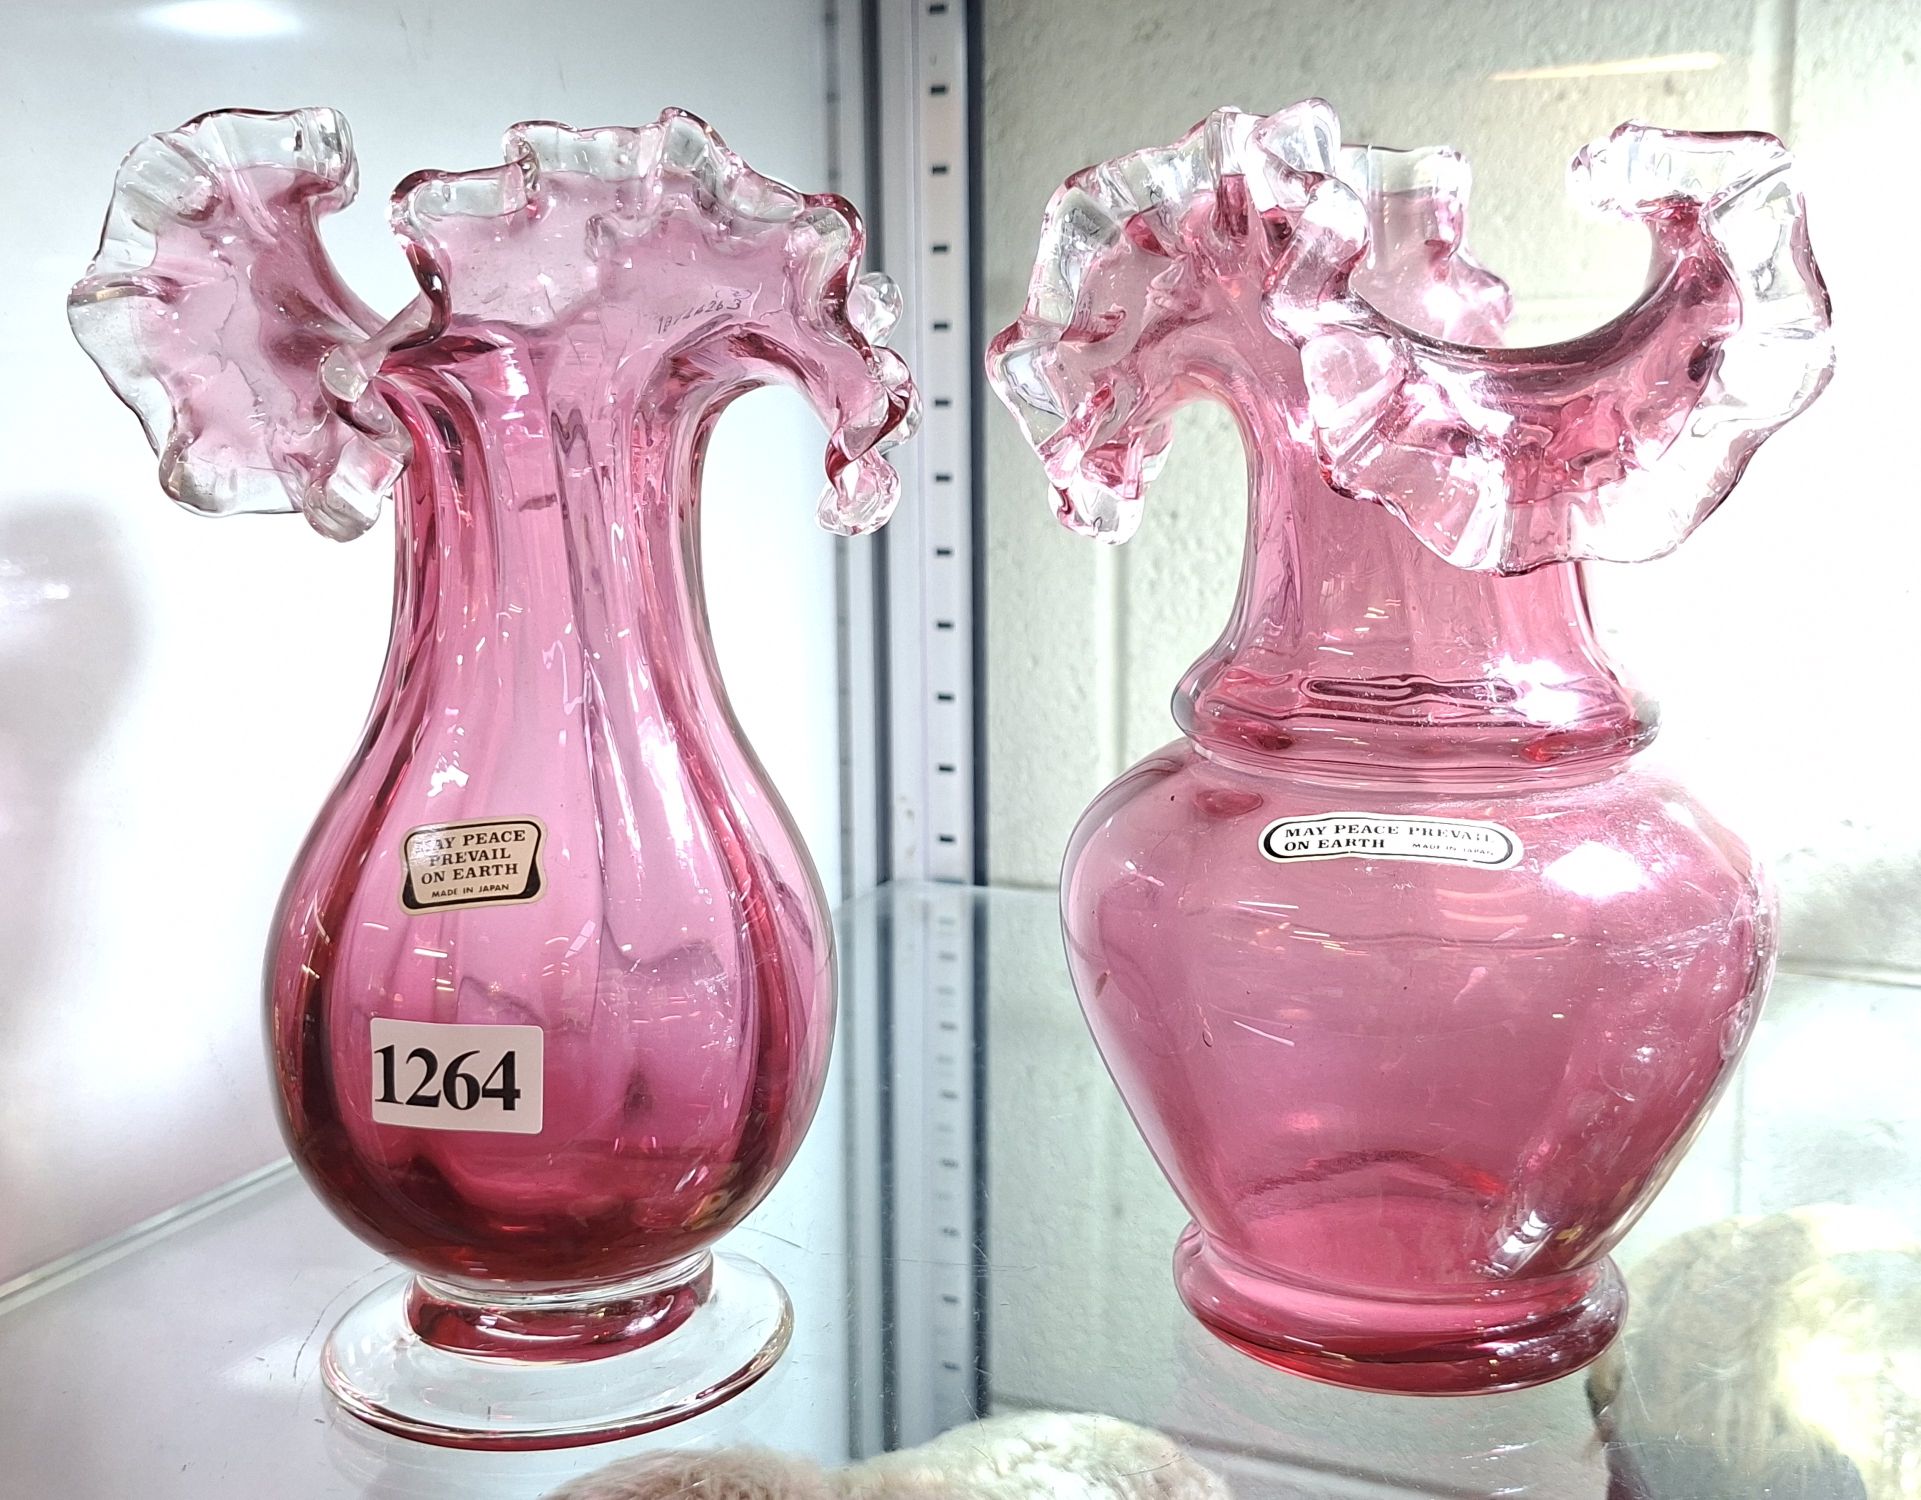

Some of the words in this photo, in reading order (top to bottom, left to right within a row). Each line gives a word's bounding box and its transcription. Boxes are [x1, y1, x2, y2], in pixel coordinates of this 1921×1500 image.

[462, 829, 526, 847] PEACE
[1285, 825, 1328, 838] MAY
[1334, 824, 1399, 836] PEACE
[1284, 840, 1309, 851] ON
[1318, 838, 1385, 849] EARTH
[429, 847, 511, 867] PREVAIL
[421, 870, 445, 885] ON
[452, 863, 519, 881] EARTH
[431, 888, 457, 898] MADE
[463, 886, 474, 894] IN
[478, 883, 509, 893] JAPAN
[374, 1044, 521, 1111] 1264
